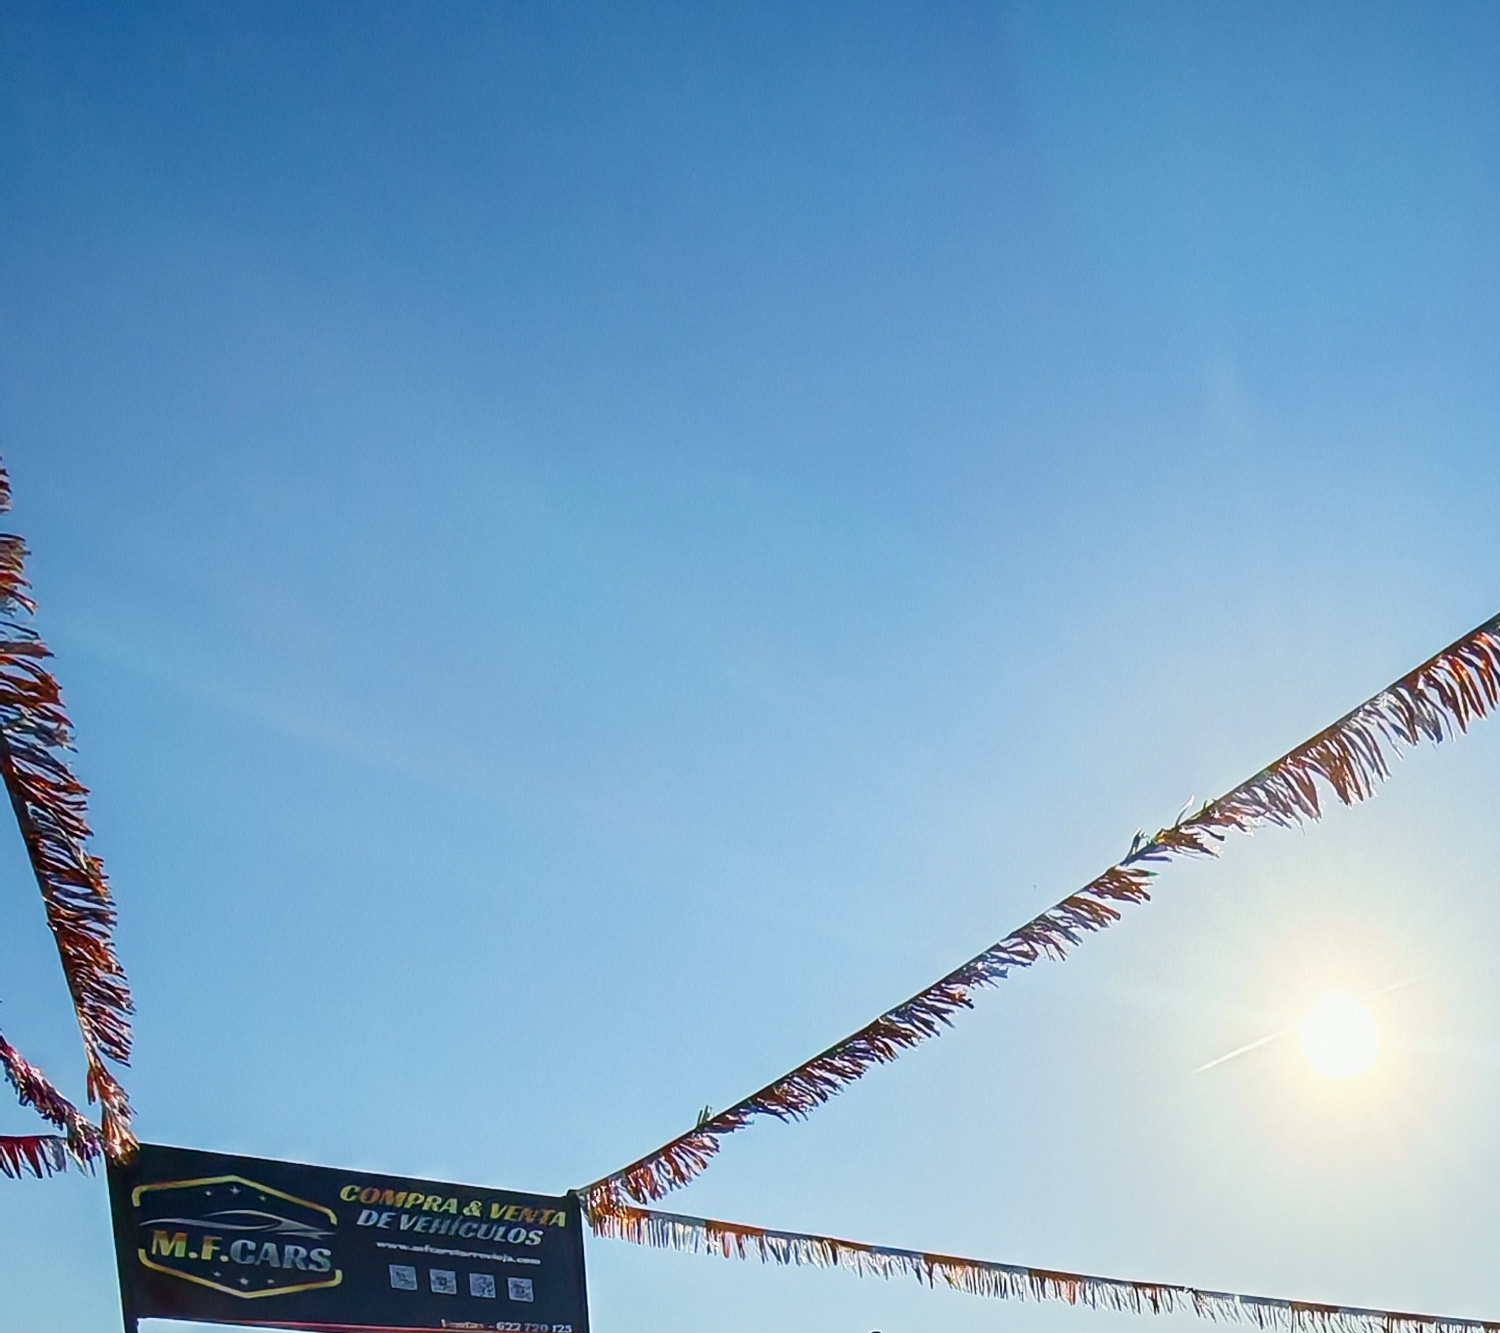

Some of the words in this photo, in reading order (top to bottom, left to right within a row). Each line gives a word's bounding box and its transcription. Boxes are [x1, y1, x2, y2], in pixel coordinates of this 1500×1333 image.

[340, 1185, 458, 1215] COMPRA
[462, 1200, 483, 1217] &
[489, 1202, 567, 1228] VENTA
[356, 1209, 397, 1229] DE
[151, 1229, 332, 1273] M.F.CARS
